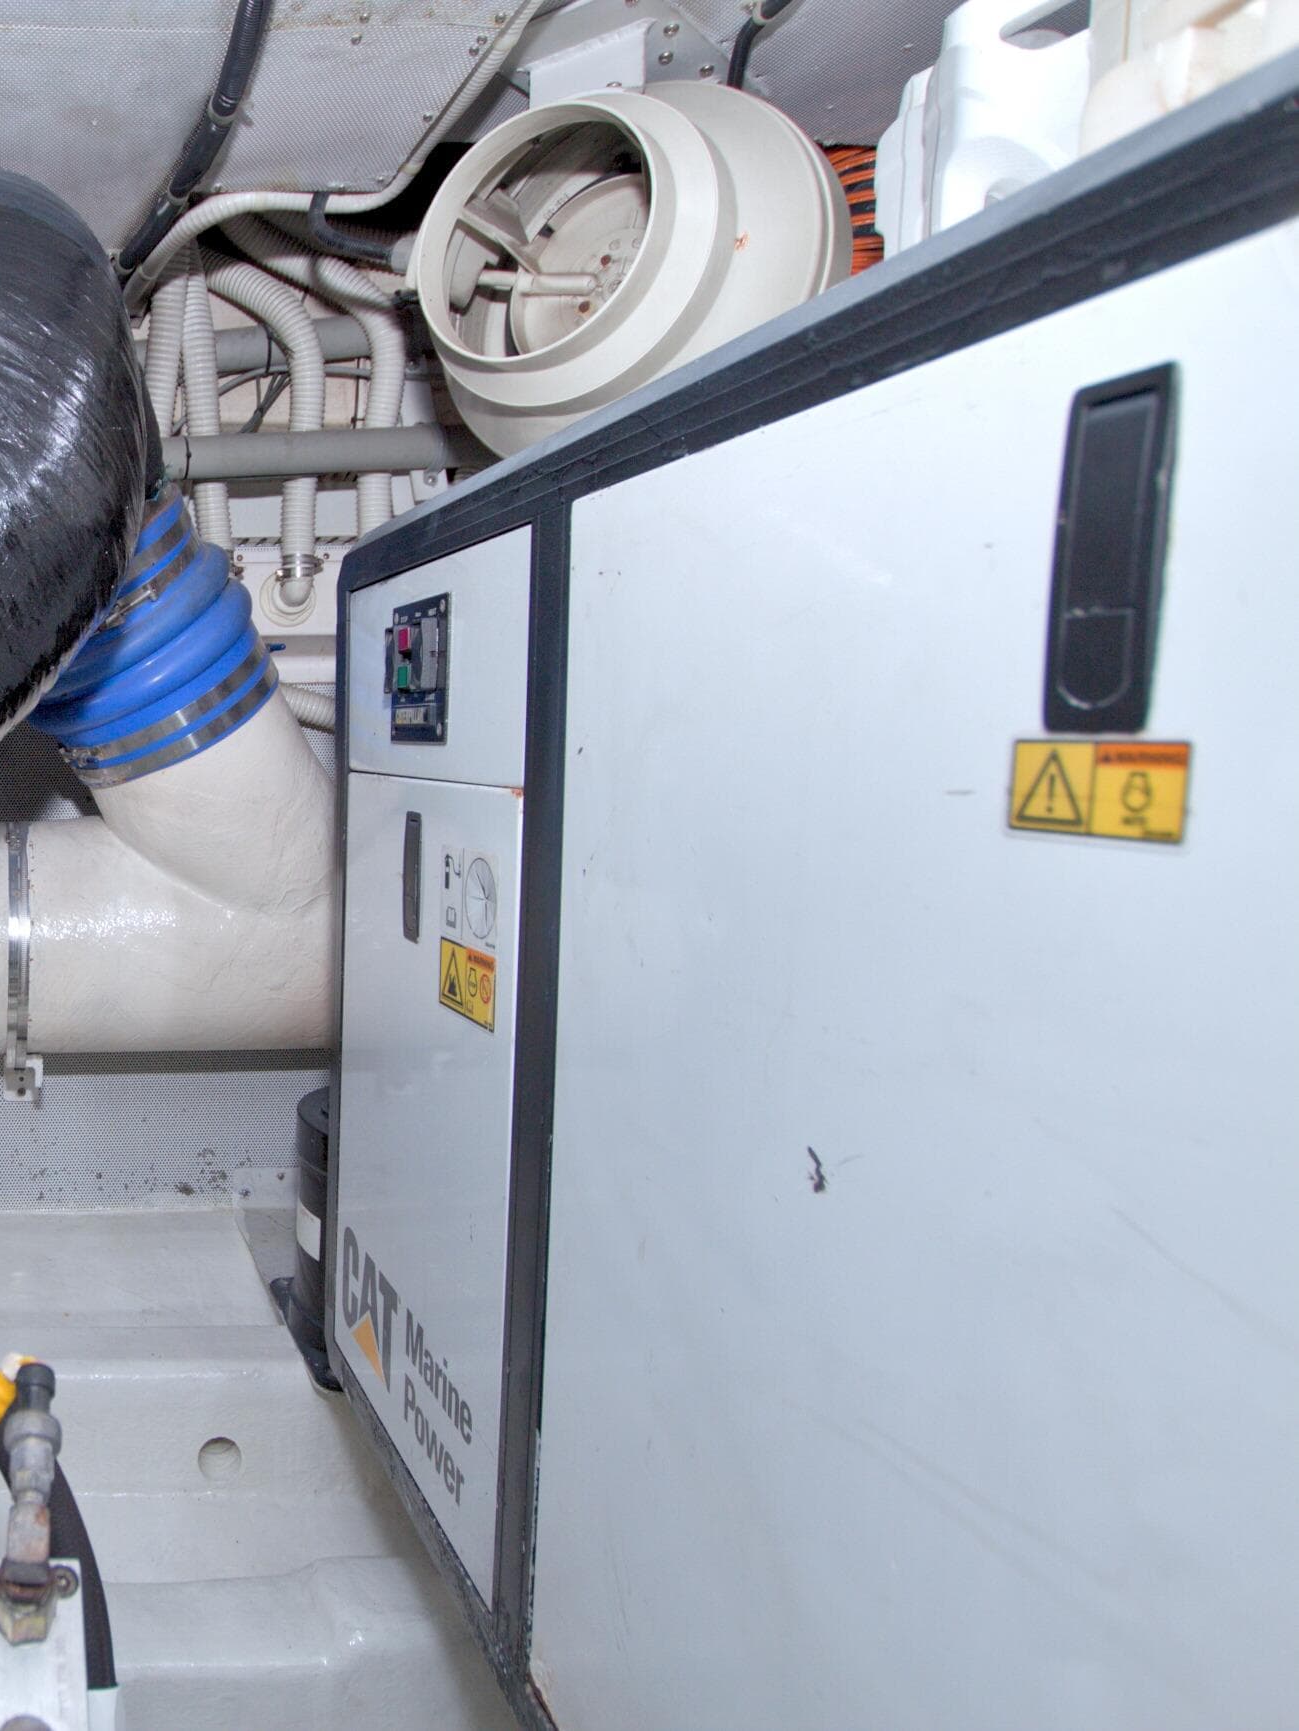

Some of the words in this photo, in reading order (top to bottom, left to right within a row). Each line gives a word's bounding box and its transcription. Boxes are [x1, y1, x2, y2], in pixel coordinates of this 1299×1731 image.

[341, 1226, 398, 1394] CAT
[405, 1307, 473, 1446] Marine
[404, 1372, 465, 1507] Power
